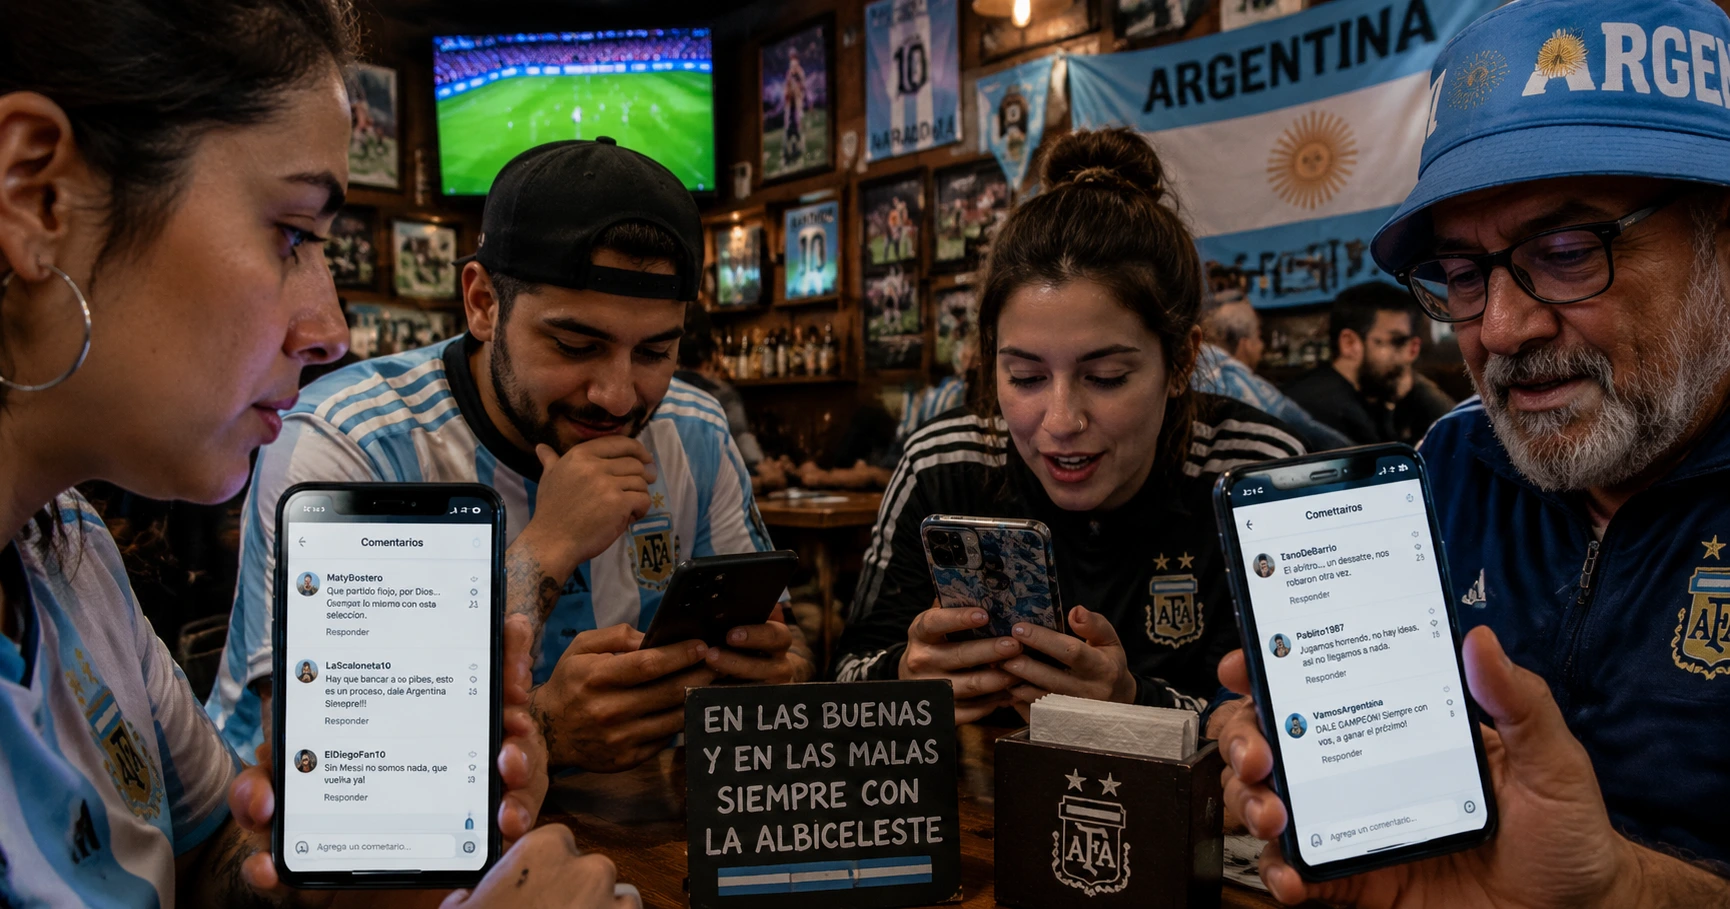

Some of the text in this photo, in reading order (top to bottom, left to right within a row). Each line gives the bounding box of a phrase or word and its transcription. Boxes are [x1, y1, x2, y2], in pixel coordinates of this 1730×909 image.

[1143, 0, 1437, 114] ARGENTINA
[893, 43, 927, 94] 10
[800, 232, 826, 276] 10
[361, 537, 424, 547] Comentarios
[641, 533, 671, 574] AFA
[1326, 559, 1337, 567] un
[1375, 550, 1390, 558] nos
[326, 573, 383, 583] MatyBostero
[1286, 569, 1352, 588] robaron otra vez.
[326, 587, 344, 596] Que
[346, 587, 375, 597] partido
[399, 588, 413, 597] por
[1289, 590, 1330, 605] Responder
[1156, 596, 1193, 631] AFA
[326, 628, 370, 638] Responder
[1299, 641, 1335, 657] Jugamos
[1372, 631, 1382, 640] no
[1382, 629, 1396, 641] hay
[325, 661, 391, 670] LaScaloneta10
[1315, 656, 1326, 664] no
[325, 676, 341, 685] Hay
[343, 676, 359, 685] que
[360, 675, 388, 684] bancar
[408, 675, 434, 685] pibes,
[436, 676, 454, 684] esto
[1305, 669, 1346, 684] Responder
[349, 688, 385, 697] proceso,
[405, 687, 446, 697] Argentina
[324, 717, 369, 726] Responder
[704, 700, 932, 734] EN LAS BUENAS
[1315, 722, 1337, 734] DALE
[1414, 703, 1428, 713] con
[1318, 737, 1335, 747] vos,
[1336, 735, 1342, 743] a
[1343, 731, 1365, 743] ganar
[324, 750, 386, 760] ElDiegoFan10
[703, 739, 939, 774] Y EN LAS MALAS
[1321, 749, 1363, 764] Responder
[324, 763, 338, 772] Sin
[406, 763, 430, 773] nada,
[432, 765, 448, 774] que
[323, 793, 368, 803] Responder
[717, 778, 919, 814] SIEMPRE CON
[705, 815, 943, 856] LA ALBICELESTE
[1330, 828, 1356, 842] Agrega
[317, 843, 348, 852] Agrega
[1065, 821, 1117, 877] AFA
